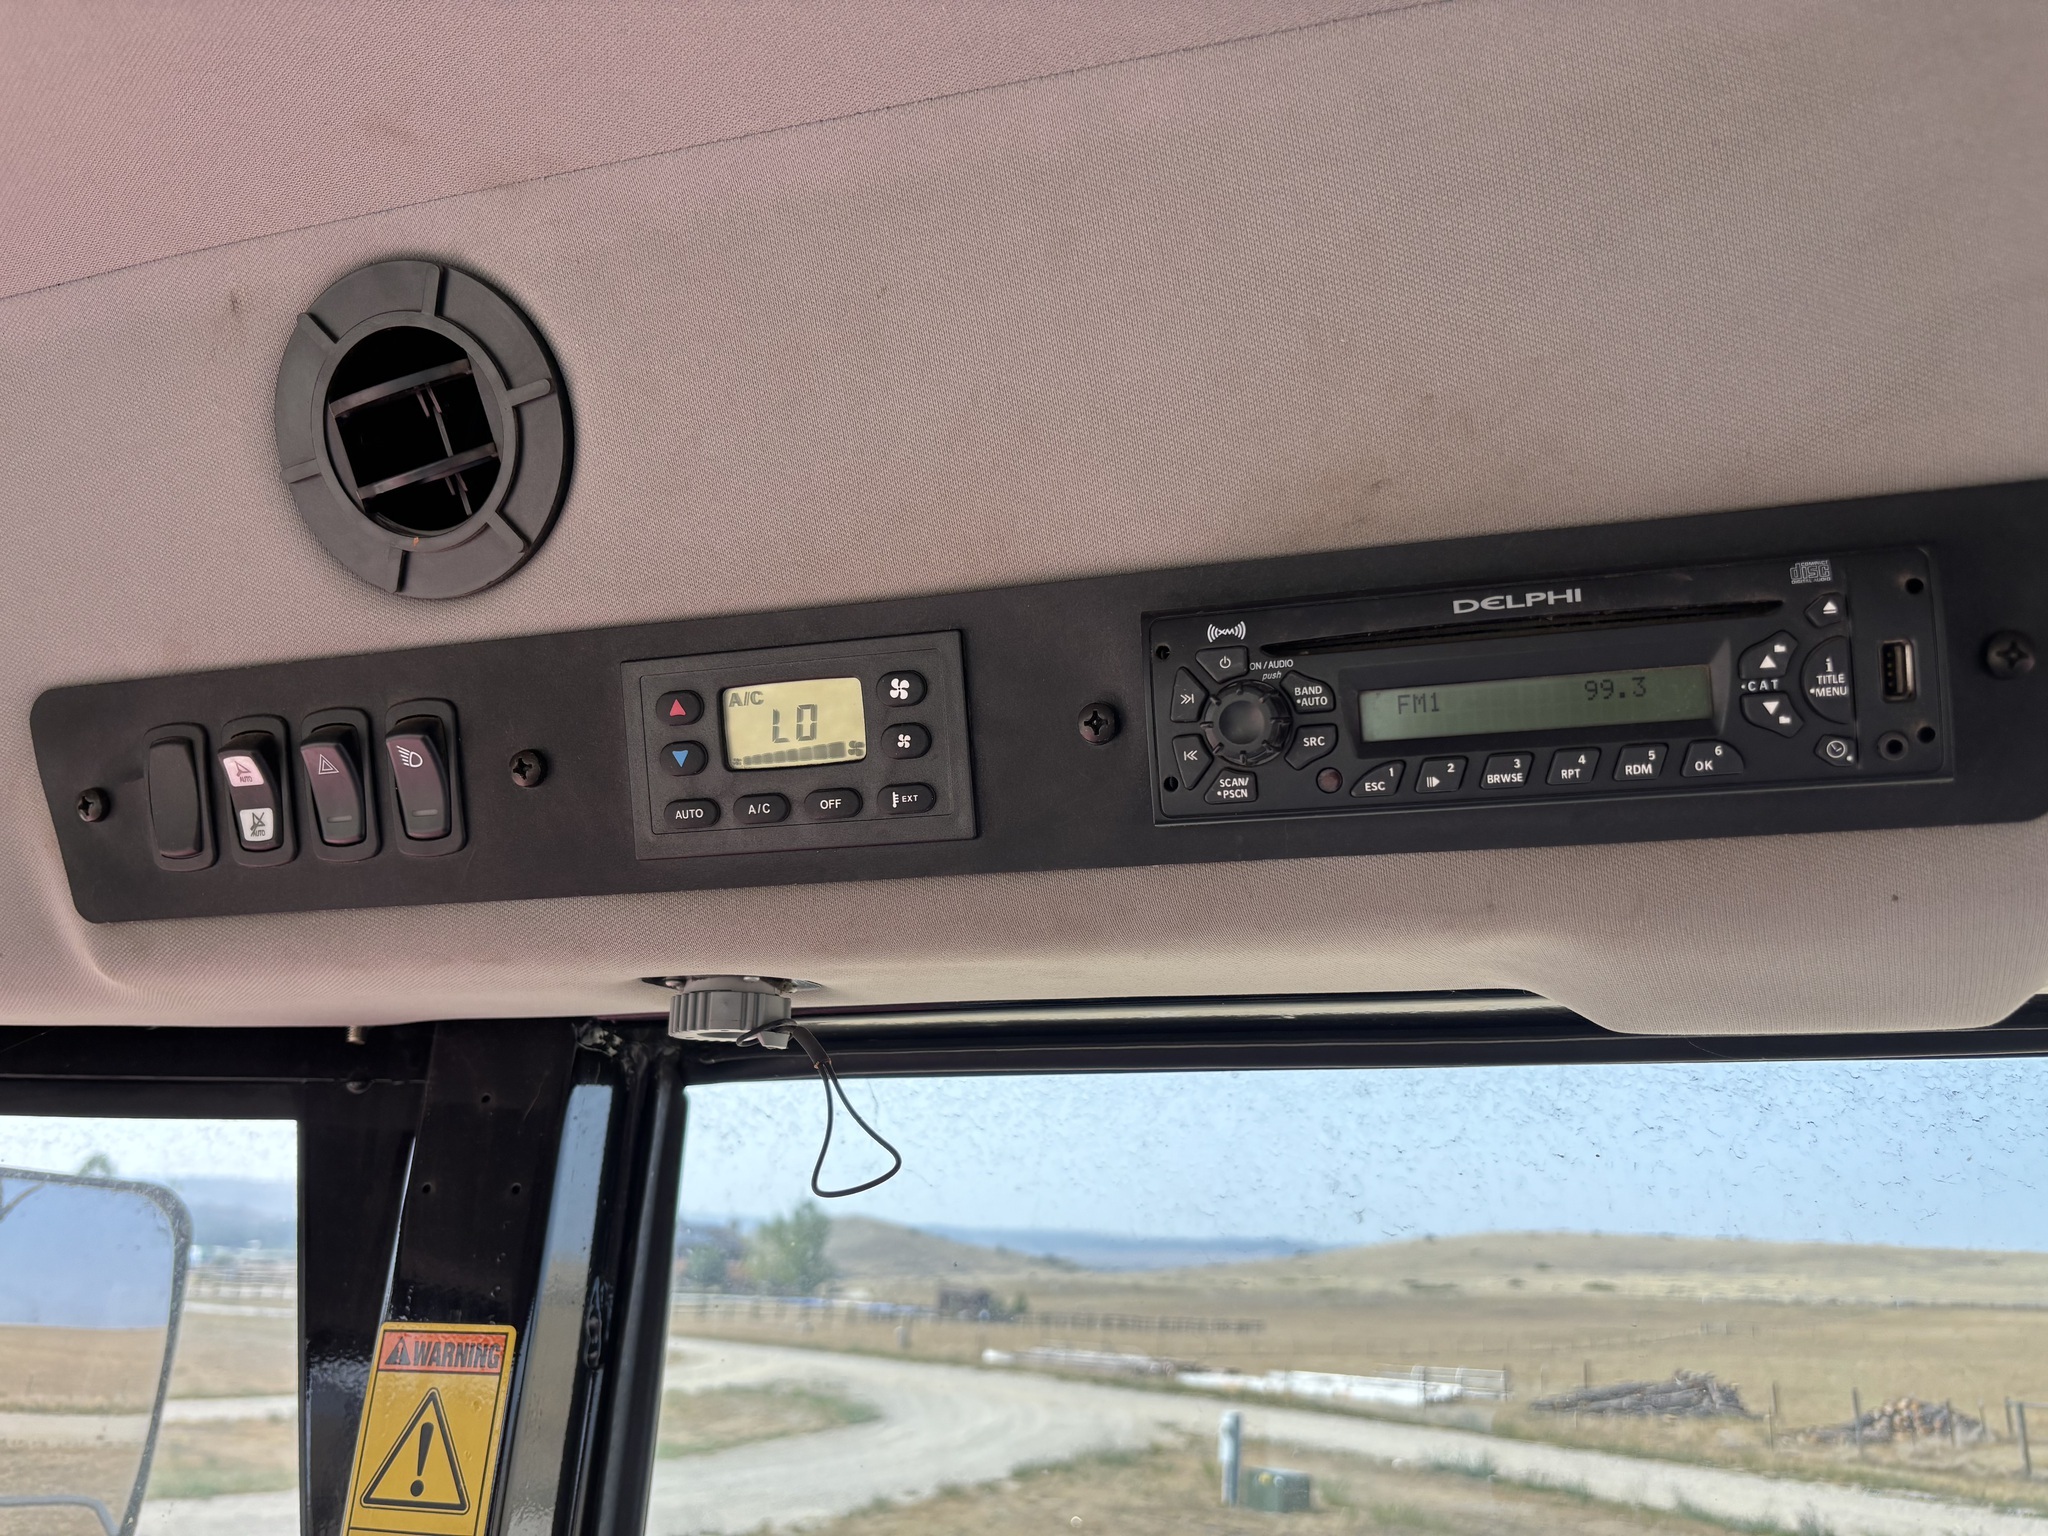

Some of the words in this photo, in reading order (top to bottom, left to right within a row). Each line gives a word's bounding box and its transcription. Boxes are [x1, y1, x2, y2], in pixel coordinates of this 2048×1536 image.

[1452, 588, 1582, 614] DELPHI
[1261, 671, 1282, 681] push
[1816, 674, 1846, 685] TITLE
[1294, 685, 1323, 696] BAND
[1584, 676, 1646, 701] 99.3
[728, 690, 765, 708] A/C
[1398, 692, 1440, 715] FM1
[1303, 736, 1326, 747] SRC
[1648, 750, 1656, 760] 5
[1714, 746, 1723, 756] 6
[1513, 758, 1521, 768] 3
[1577, 754, 1586, 765] 4
[1447, 763, 1455, 773] 2
[1625, 764, 1653, 776] RDM
[1694, 760, 1714, 771] OK
[1388, 767, 1394, 777] 1
[1560, 768, 1581, 780] RPT
[1486, 772, 1524, 784] BRWSE
[1364, 781, 1386, 792] ESC
[901, 793, 919, 803] EXT
[747, 802, 771, 815] A/C
[819, 798, 842, 811] OFF
[674, 807, 704, 820] AUTO
[413, 1340, 501, 1369] WARNING
